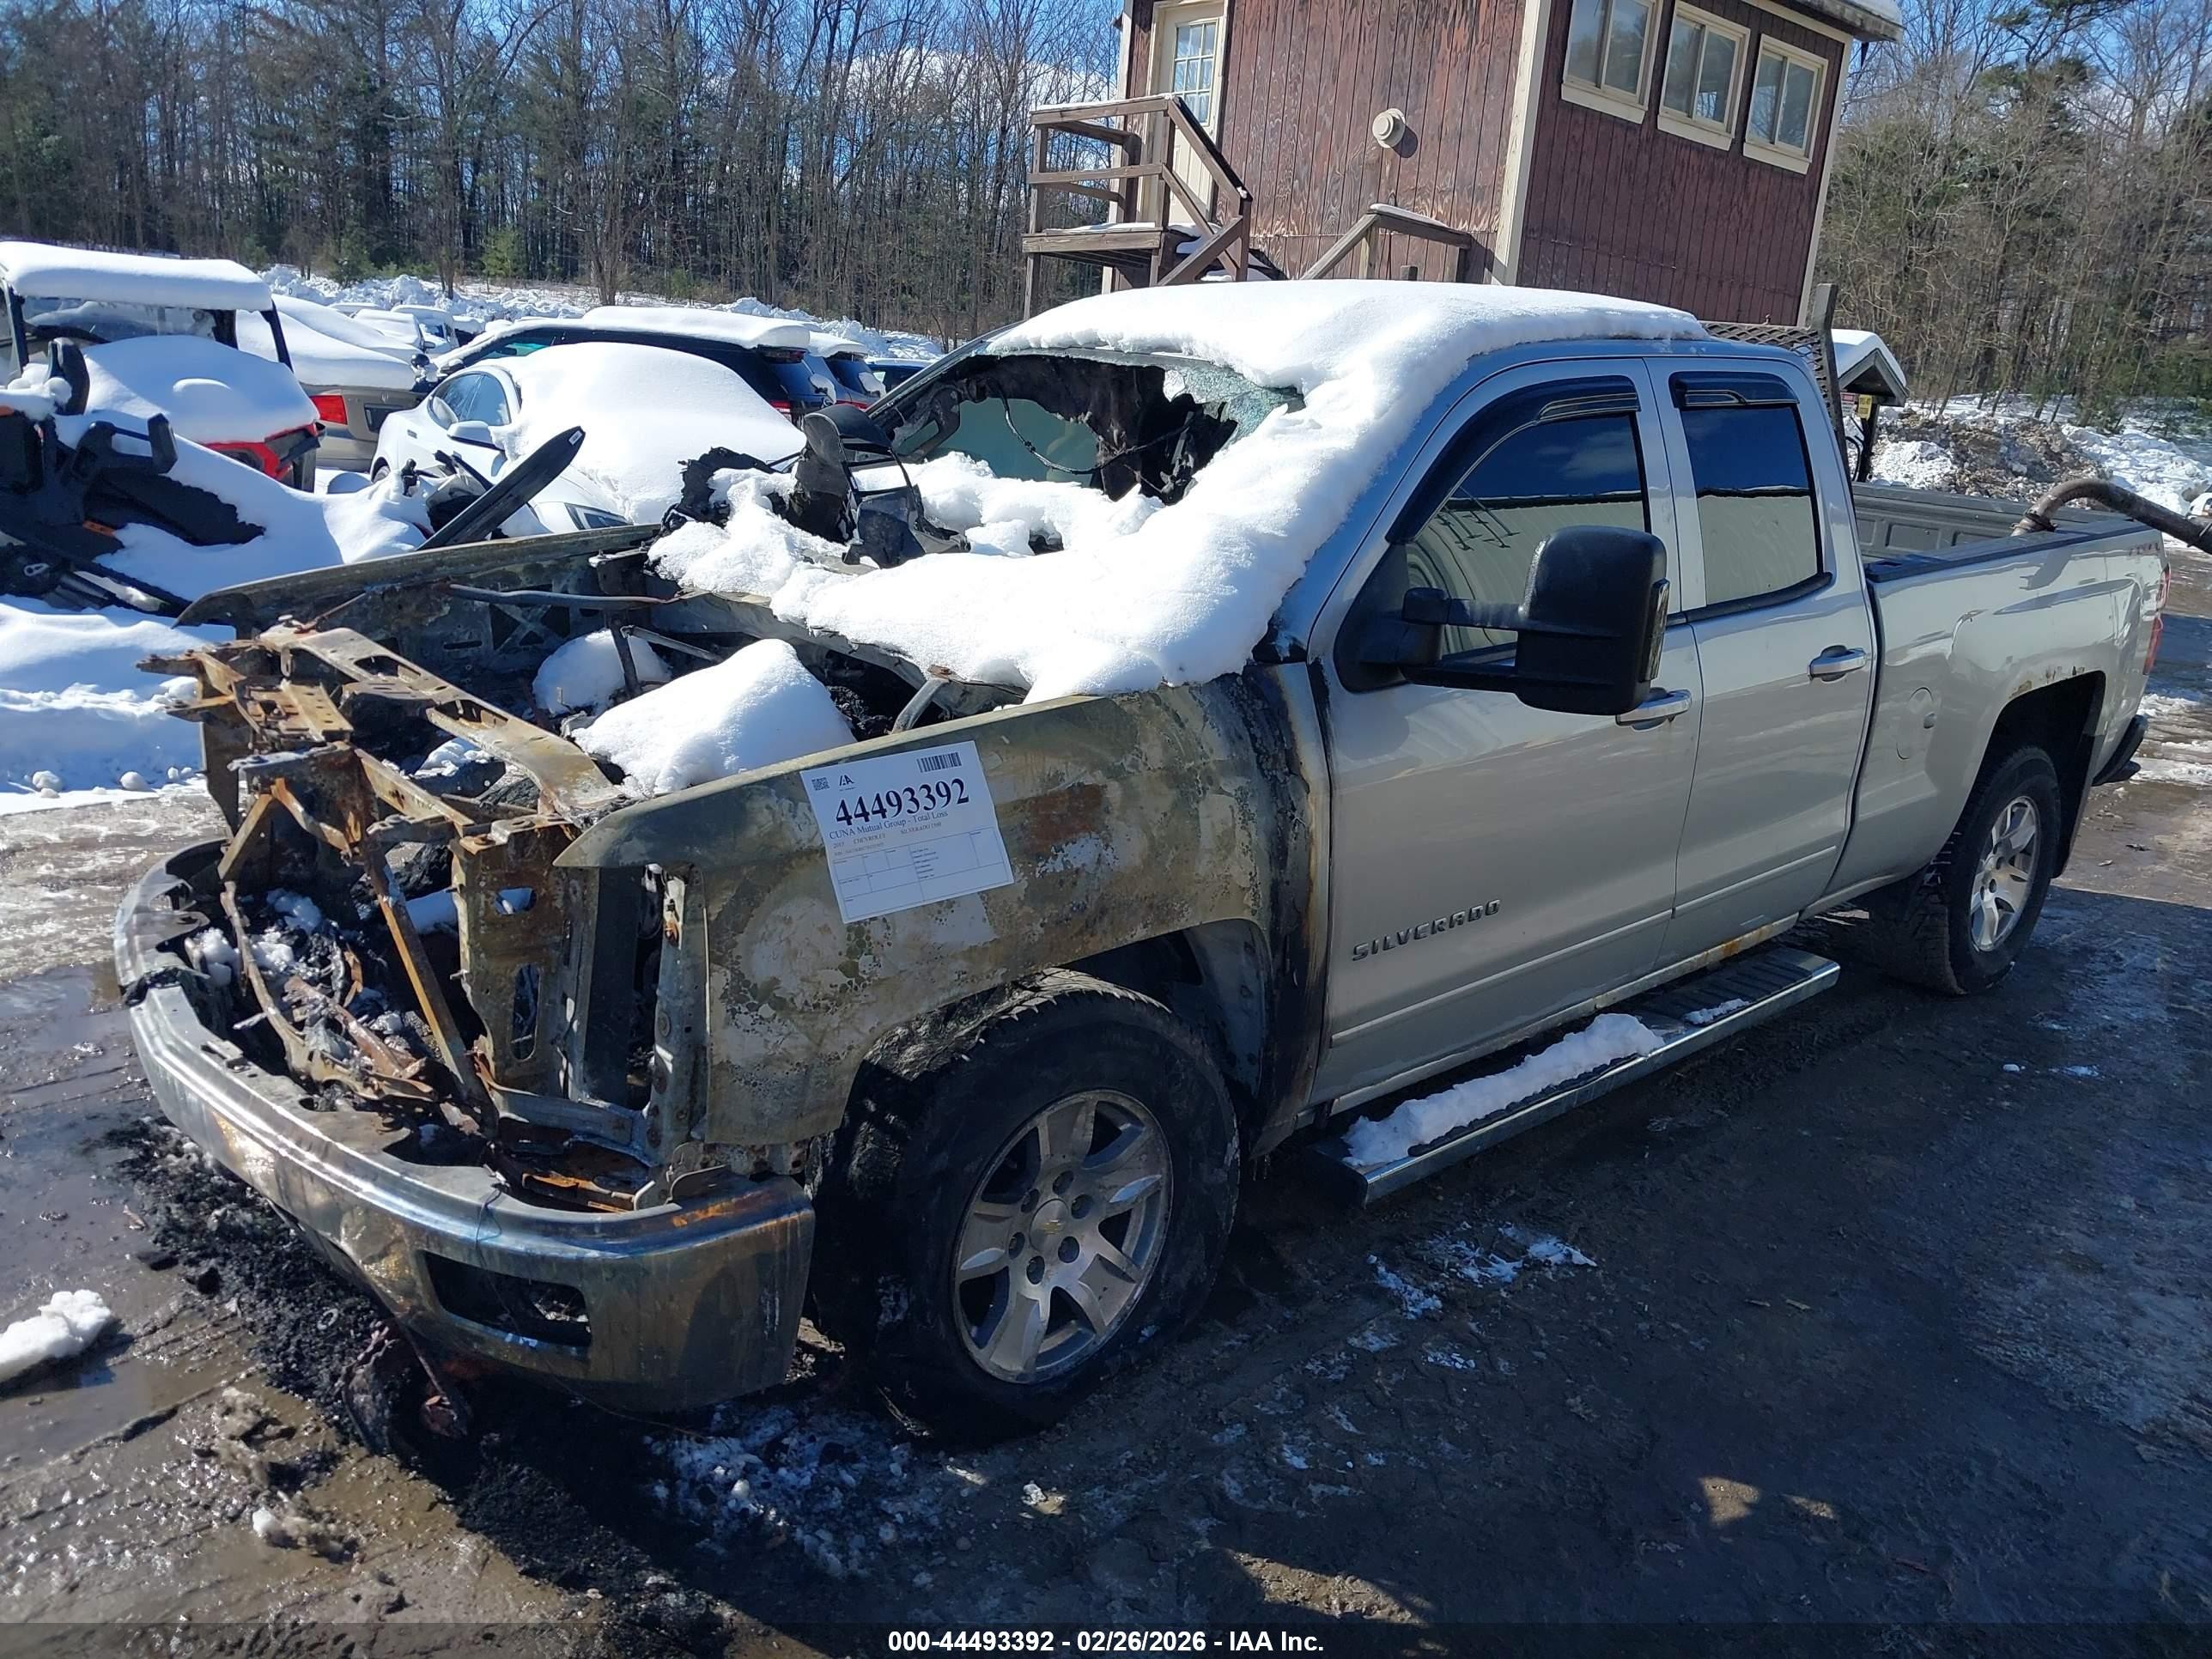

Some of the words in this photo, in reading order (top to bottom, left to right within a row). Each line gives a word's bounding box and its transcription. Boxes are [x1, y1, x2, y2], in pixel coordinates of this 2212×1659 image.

[829, 829, 856, 841] CUNA
[857, 822, 884, 837] Mutual
[884, 817, 907, 833] Group
[912, 814, 931, 825] Total
[933, 810, 949, 820] Loss
[836, 778, 969, 826] 44493392
[1352, 898, 1501, 962] SILVERADO
